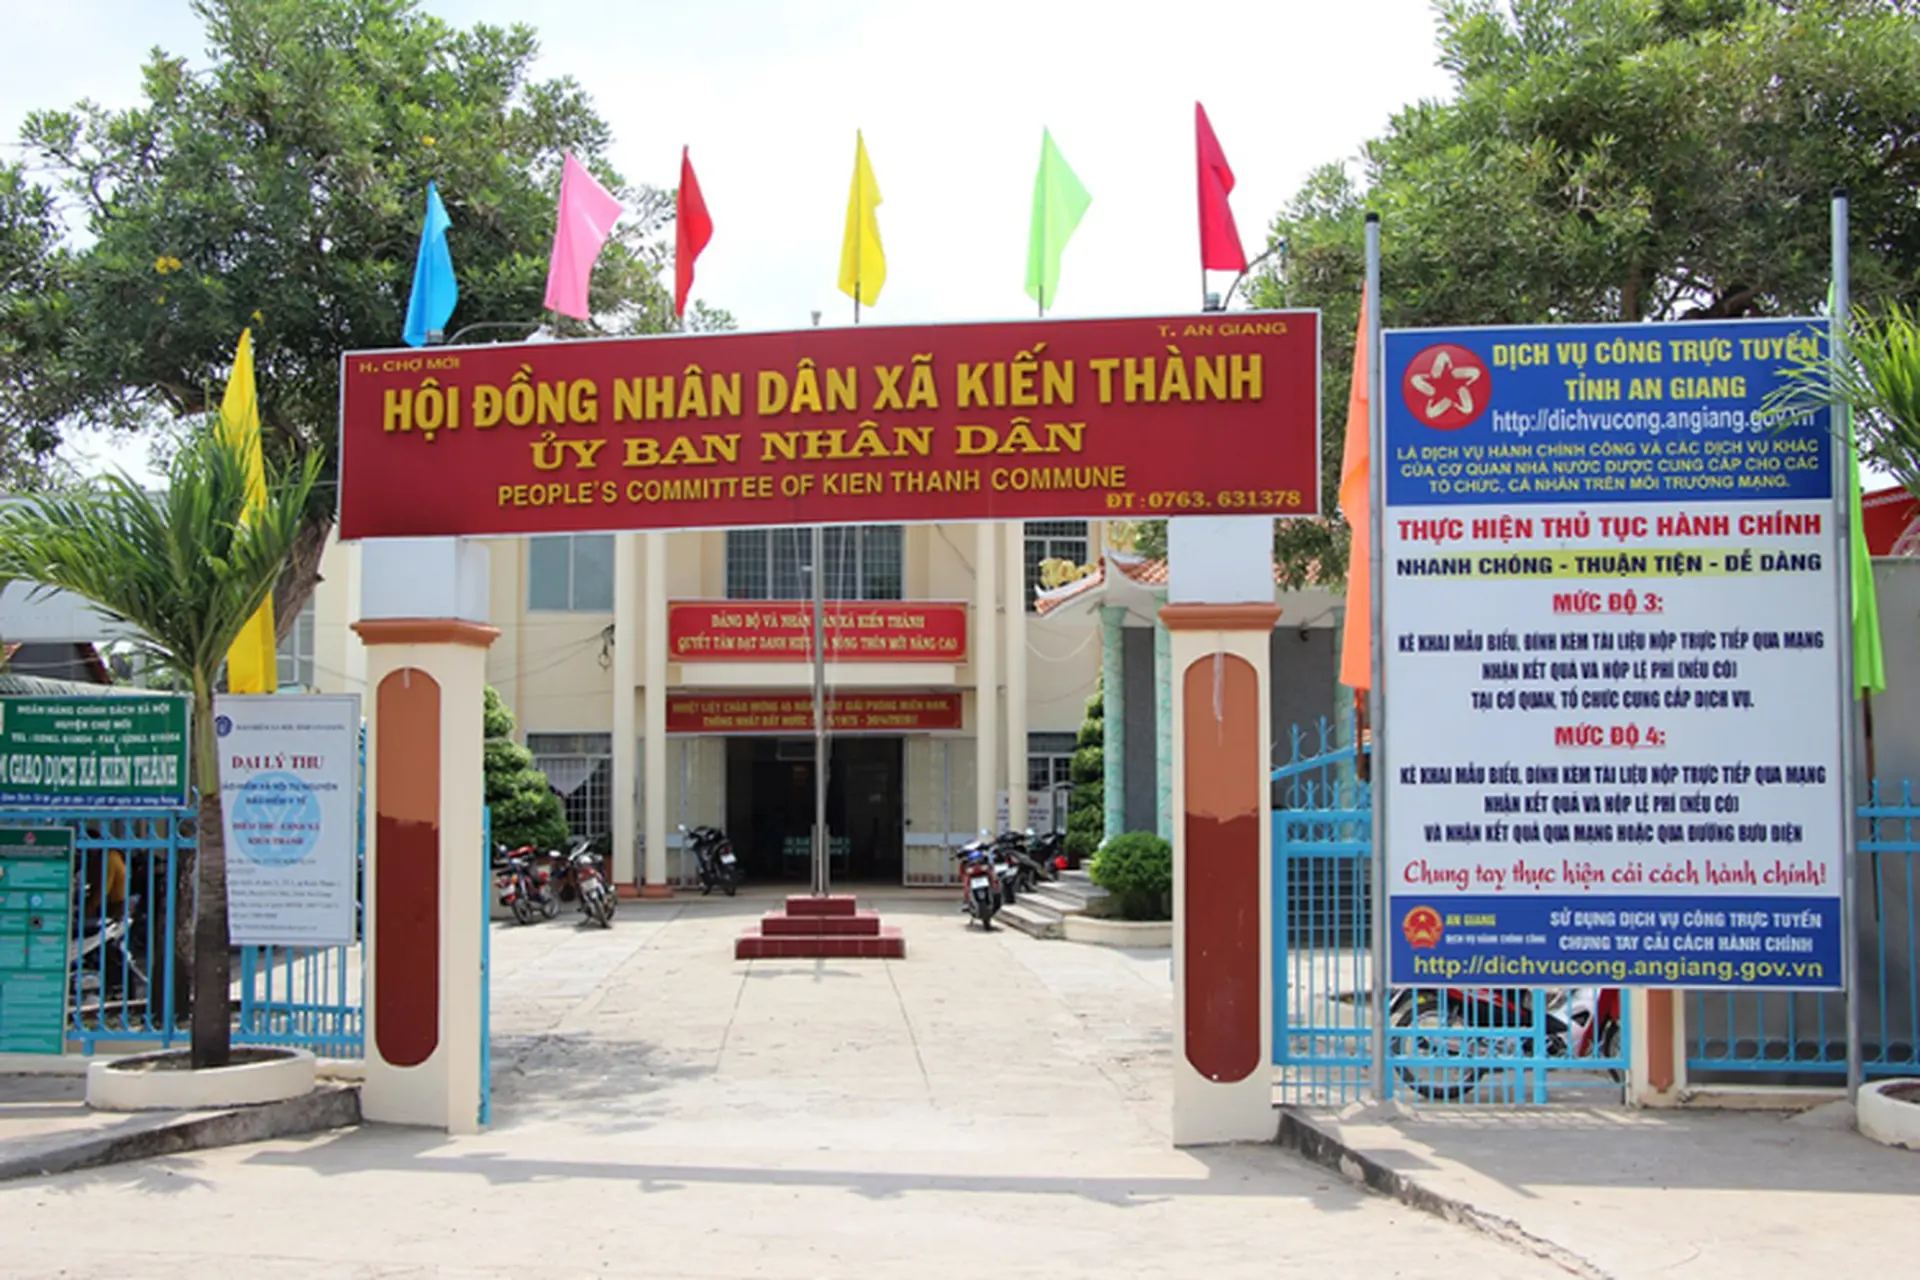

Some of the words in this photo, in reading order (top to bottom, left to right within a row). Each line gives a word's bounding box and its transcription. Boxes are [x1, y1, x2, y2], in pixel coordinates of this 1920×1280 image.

[1157, 324, 1177, 337] T.
[1183, 323, 1214, 337] AN
[1218, 322, 1287, 336] GIANG
[359, 362, 379, 373] H.
[382, 359, 422, 374] CHỢ
[426, 356, 460, 370] MỚI
[1492, 343, 1549, 370] DỊCH
[1556, 342, 1587, 369] VỤ
[1595, 336, 1662, 365] CÔNG
[1669, 337, 1732, 367] TRỰC
[383, 376, 459, 441] HỘI
[472, 364, 598, 428] ĐỒNG
[613, 364, 741, 422] NHÂN
[758, 357, 857, 416] DÂN
[873, 353, 939, 411] XÃ
[957, 342, 1074, 408] KIẾN
[1089, 344, 1262, 404] THÀNH
[1565, 373, 1620, 401] TỈNH
[1628, 378, 1662, 400] AN
[1670, 376, 1747, 399] GIANG
[1492, 404, 1815, 437] http://dichvucong.angiang.govvn
[529, 432, 607, 469] ỦY
[622, 434, 741, 467] BAN
[760, 419, 934, 462] NHÂN
[955, 416, 1086, 456] DÂN
[1397, 445, 1417, 460] LÀ
[1422, 445, 1459, 462] DỊCH
[1463, 444, 1484, 460] VỤ
[1488, 442, 1532, 458] HÀNH
[1536, 441, 1585, 457] CHÍNH
[1590, 440, 1635, 456] CÔNG
[1640, 438, 1662, 455] VÀ
[1666, 438, 1699, 455] CÁC
[1704, 438, 1742, 456] DỊCH
[1746, 438, 1769, 455] VỤ
[1773, 436, 1819, 453] KHÁC
[1401, 460, 1434, 477] CỦA
[1438, 463, 1462, 477] CƠ
[1466, 462, 1511, 476] QUAN
[1515, 459, 1549, 474] NHÀ
[1658, 458, 1704, 472] CUNG
[1745, 456, 1780, 470] CHO
[1784, 454, 1819, 469] CÁC
[498, 480, 618, 507] PEOPLE'S
[626, 476, 773, 502] COMMITTEE
[781, 474, 814, 497] OF
[822, 472, 882, 494] KIEN
[891, 469, 981, 492] THANH
[990, 466, 1126, 491] COMMUNE
[1535, 475, 1579, 491] NHÂN
[1584, 476, 1625, 489] TRÊN
[1630, 474, 1659, 489] MÔI
[1217, 489, 1301, 507] 631378
[1398, 517, 1464, 545] THỰC
[1472, 514, 1534, 544] HIỆN
[1541, 510, 1591, 539] THỦ
[1598, 516, 1648, 543] TỤC
[1656, 511, 1730, 537] HÀNH
[1738, 510, 1821, 536] CHÍNH
[1397, 558, 1472, 576] NHANH
[1479, 554, 1553, 575] CHÓNG
[1575, 552, 1647, 577] THUẬN
[1654, 552, 1703, 577] TIỆN
[1760, 550, 1822, 572] DÀNG
[1552, 589, 1601, 614] MỨC
[1608, 588, 1638, 616] ĐỘ
[1644, 593, 1664, 613] 3:
[1418, 634, 1450, 652] KHAI
[1720, 627, 1749, 650] TIẾP
[1752, 631, 1780, 653] QUA
[1783, 631, 1824, 653] MẠNG
[1522, 657, 1546, 680] KẾT
[1472, 690, 1493, 713] TẠI
[1623, 690, 1660, 709] CUNG
[1554, 722, 1604, 746] MỨC
[1610, 722, 1640, 749] ĐỘ
[1645, 725, 1666, 746] 4:
[9, 754, 43, 785] GIAO
[44, 754, 77, 792] DỊCH
[134, 746, 178, 786] THÀNH
[291, 755, 324, 770] THU
[1404, 859, 1470, 892] Chung
[1476, 863, 1506, 891] tay
[1512, 859, 1557, 891] thực
[1563, 859, 1605, 891] hiện
[1611, 861, 1643, 884] cải
[1649, 859, 1700, 885] cách
[1705, 859, 1757, 886] hành
[1763, 859, 1826, 887] chính!
[1550, 906, 1572, 927] SỬ
[1574, 911, 1616, 930] DỤNG
[1619, 911, 1655, 930] DỊCH
[1658, 912, 1680, 931] VỤ
[1683, 908, 1726, 928] CÔNG
[1729, 911, 1769, 931] TRỰC
[1772, 908, 1822, 929] TUYẾN
[1558, 935, 1611, 951] CHUNG
[1615, 935, 1639, 951] TAY
[1673, 933, 1714, 951] CÁCH
[1718, 933, 1761, 952] HÀNH
[1765, 934, 1813, 952] CHÍNH
[1413, 955, 1823, 982] http://dichvucong.angiang.gov.vn
